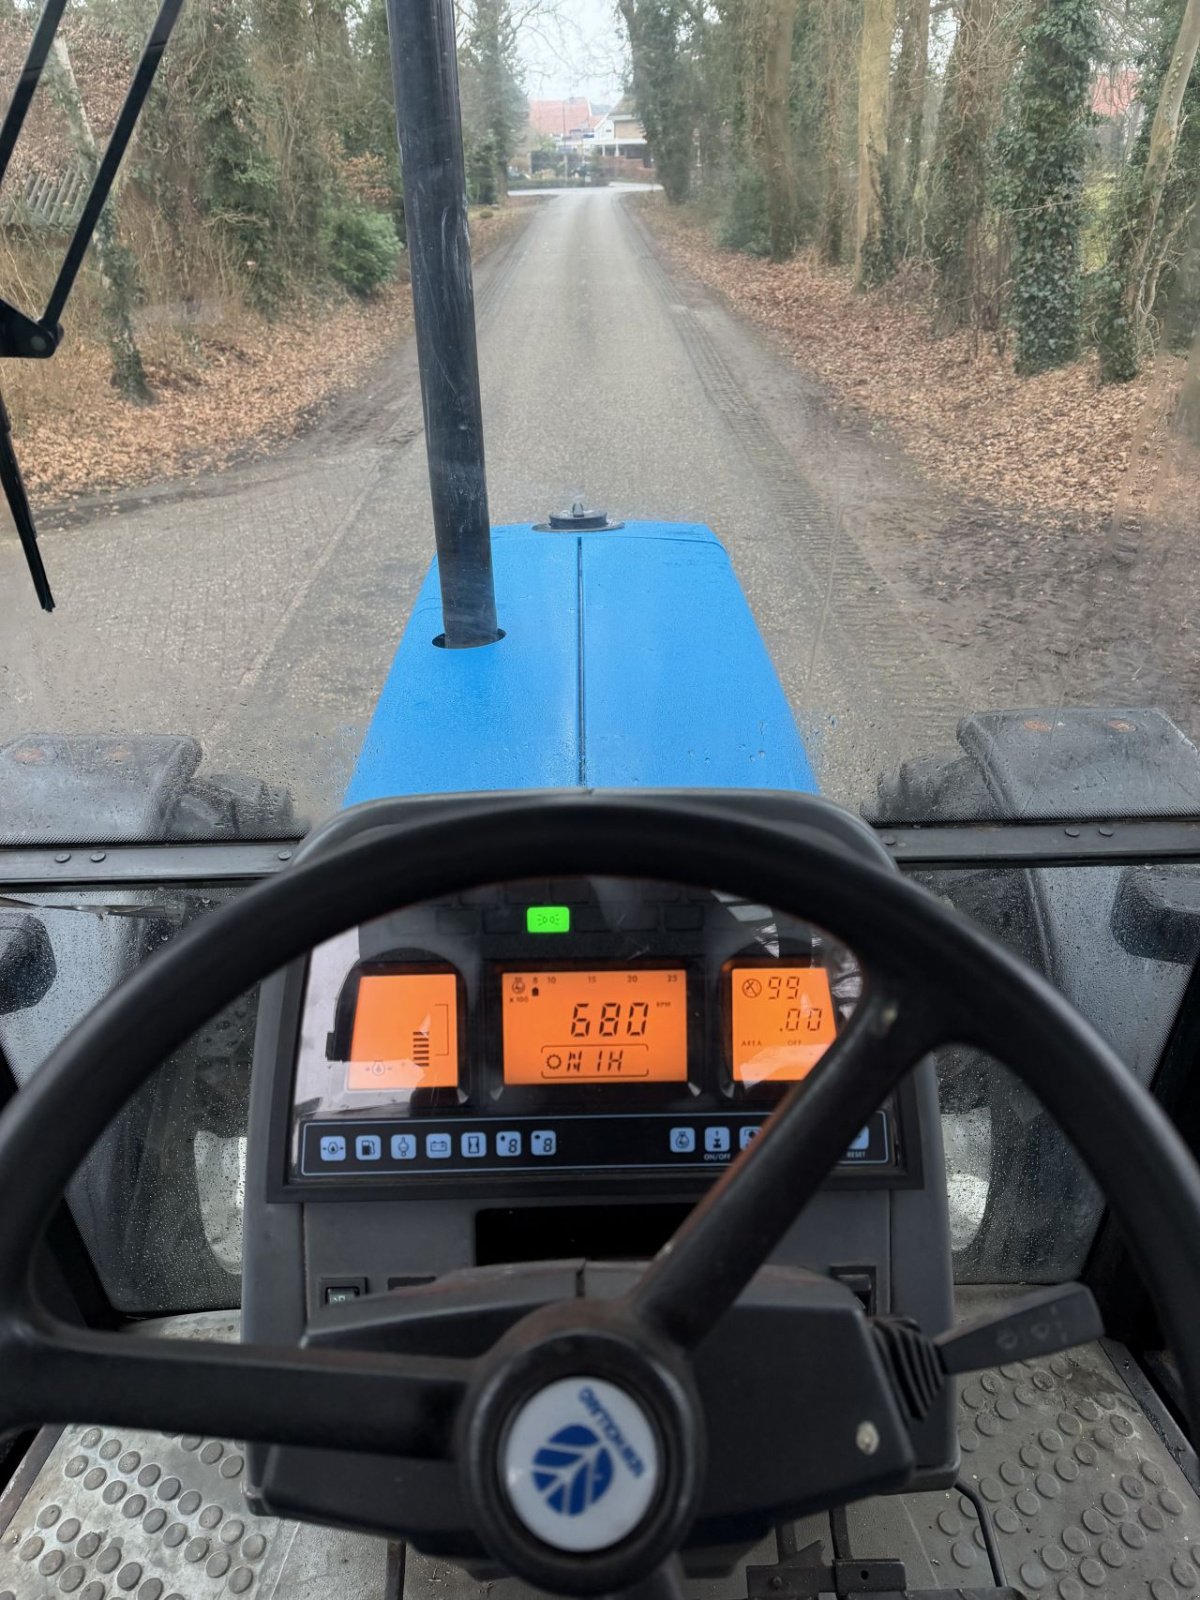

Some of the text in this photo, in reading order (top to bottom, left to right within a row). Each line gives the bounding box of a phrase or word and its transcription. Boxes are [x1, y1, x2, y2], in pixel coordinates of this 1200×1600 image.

[547, 976, 557, 984] 10
[627, 975, 638, 983] 20
[767, 976, 800, 1000] 99
[571, 1002, 649, 1037] 680
[704, 1152, 731, 1161] ON/OFF
[847, 1151, 866, 1159] RESET
